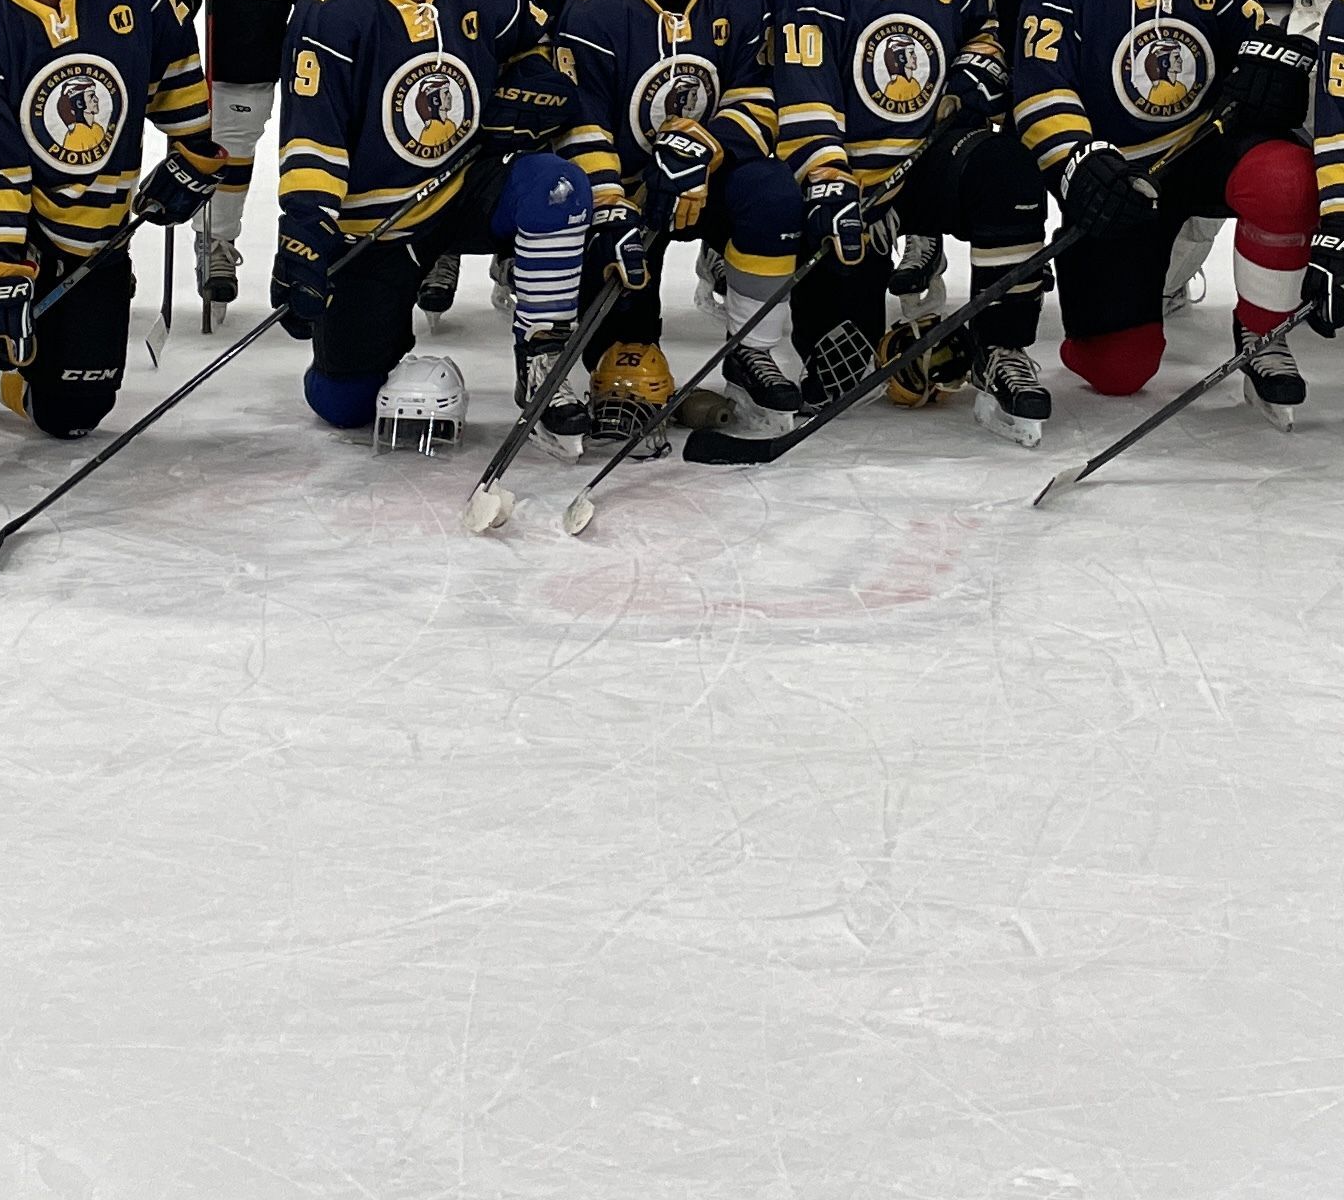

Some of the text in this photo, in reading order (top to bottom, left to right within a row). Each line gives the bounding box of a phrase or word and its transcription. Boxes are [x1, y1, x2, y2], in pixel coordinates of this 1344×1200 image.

[113, 12, 131, 30] KJ
[875, 24, 904, 41] GRAND
[1022, 15, 1064, 62] 22
[782, 22, 824, 67] 10
[35, 66, 118, 117] EAST GRAND RAPIDS
[292, 50, 321, 97] 9
[872, 82, 935, 115] PIONEERS
[48, 122, 118, 164] PIONEERS
[61, 367, 119, 382] CCM
[615, 351, 644, 369] 26
